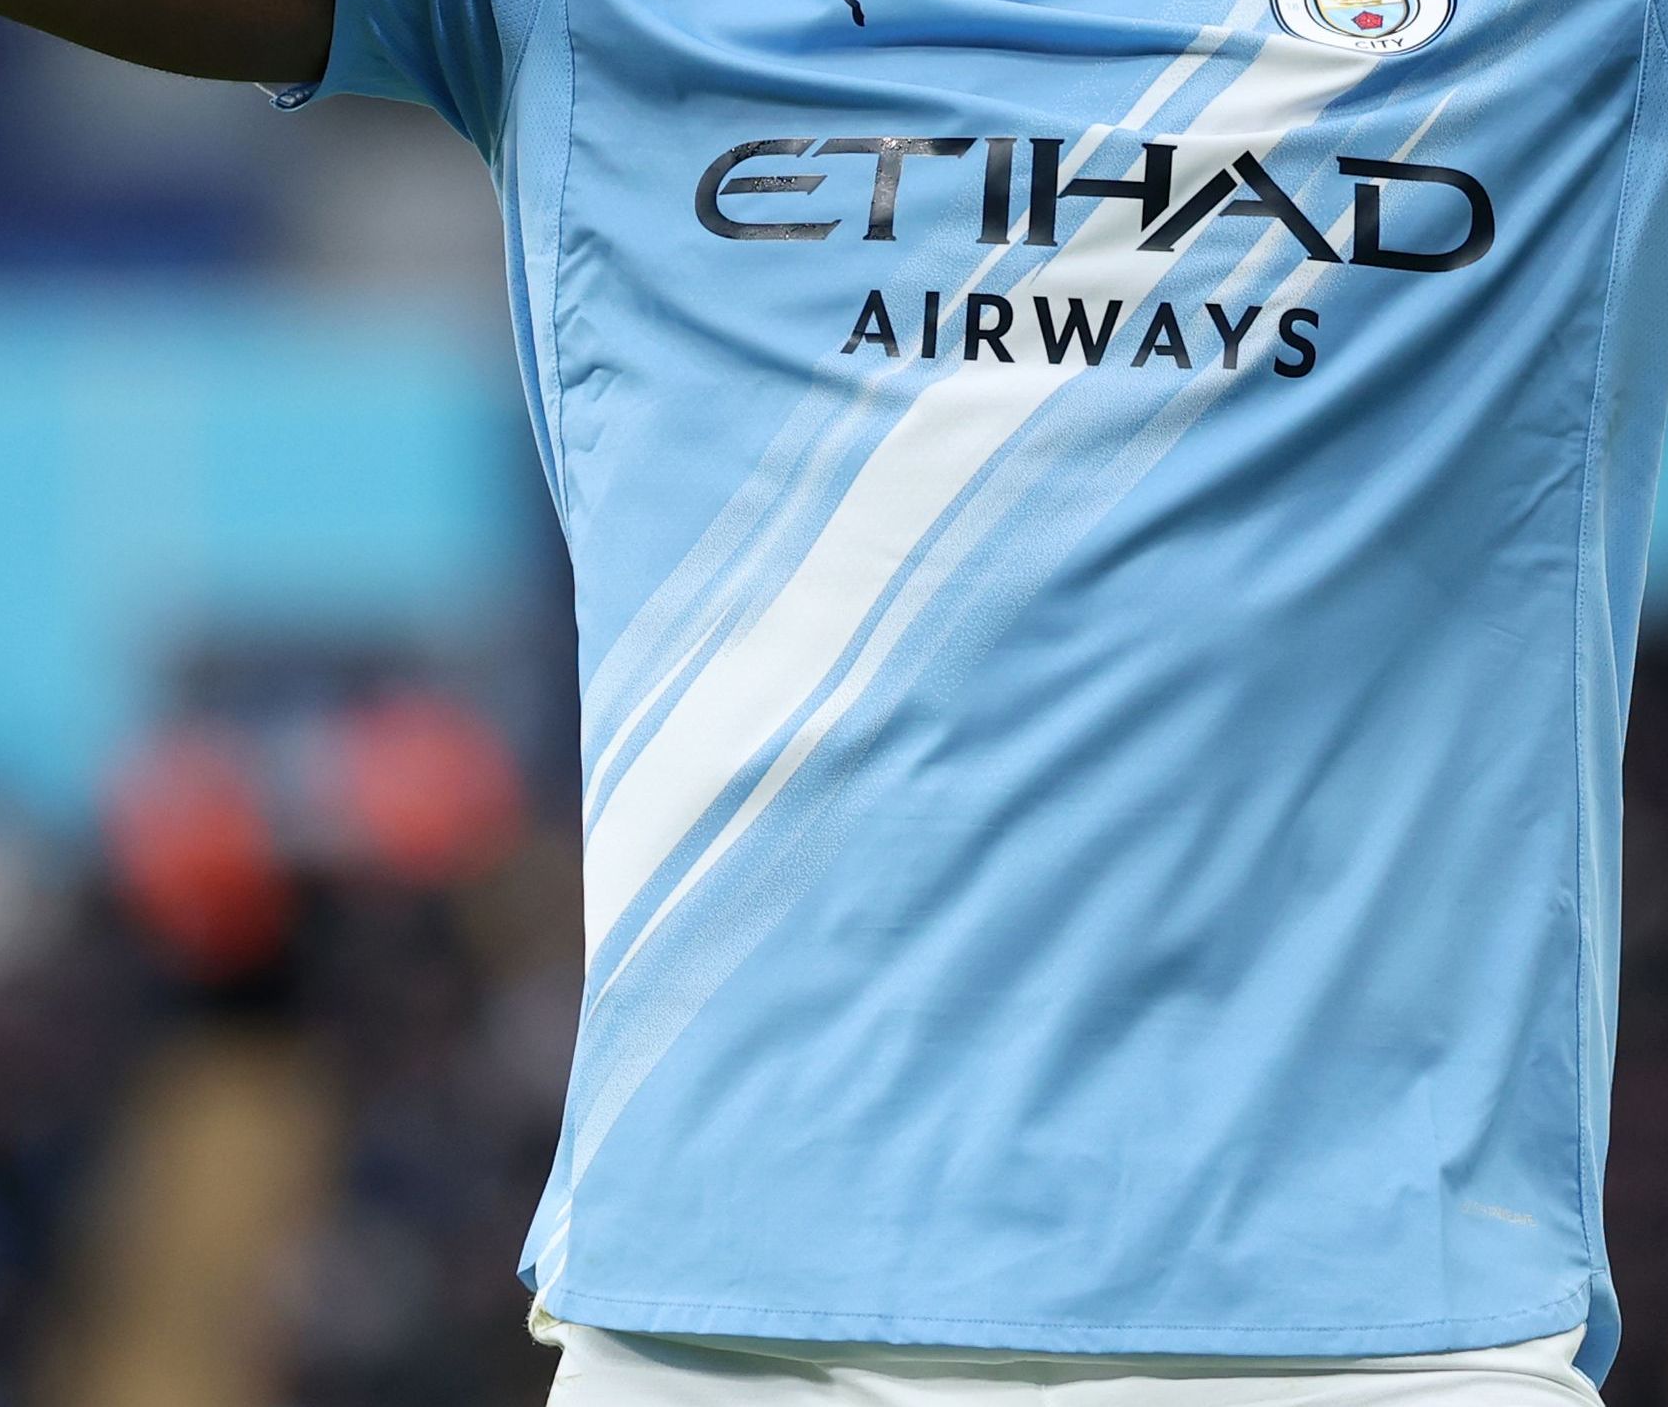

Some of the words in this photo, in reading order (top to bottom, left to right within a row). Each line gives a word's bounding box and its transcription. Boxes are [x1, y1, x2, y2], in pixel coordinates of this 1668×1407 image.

[1355, 38, 1403, 49] CITY
[693, 136, 1495, 273] ETIHAD
[840, 289, 1321, 378] AIRWAYS
